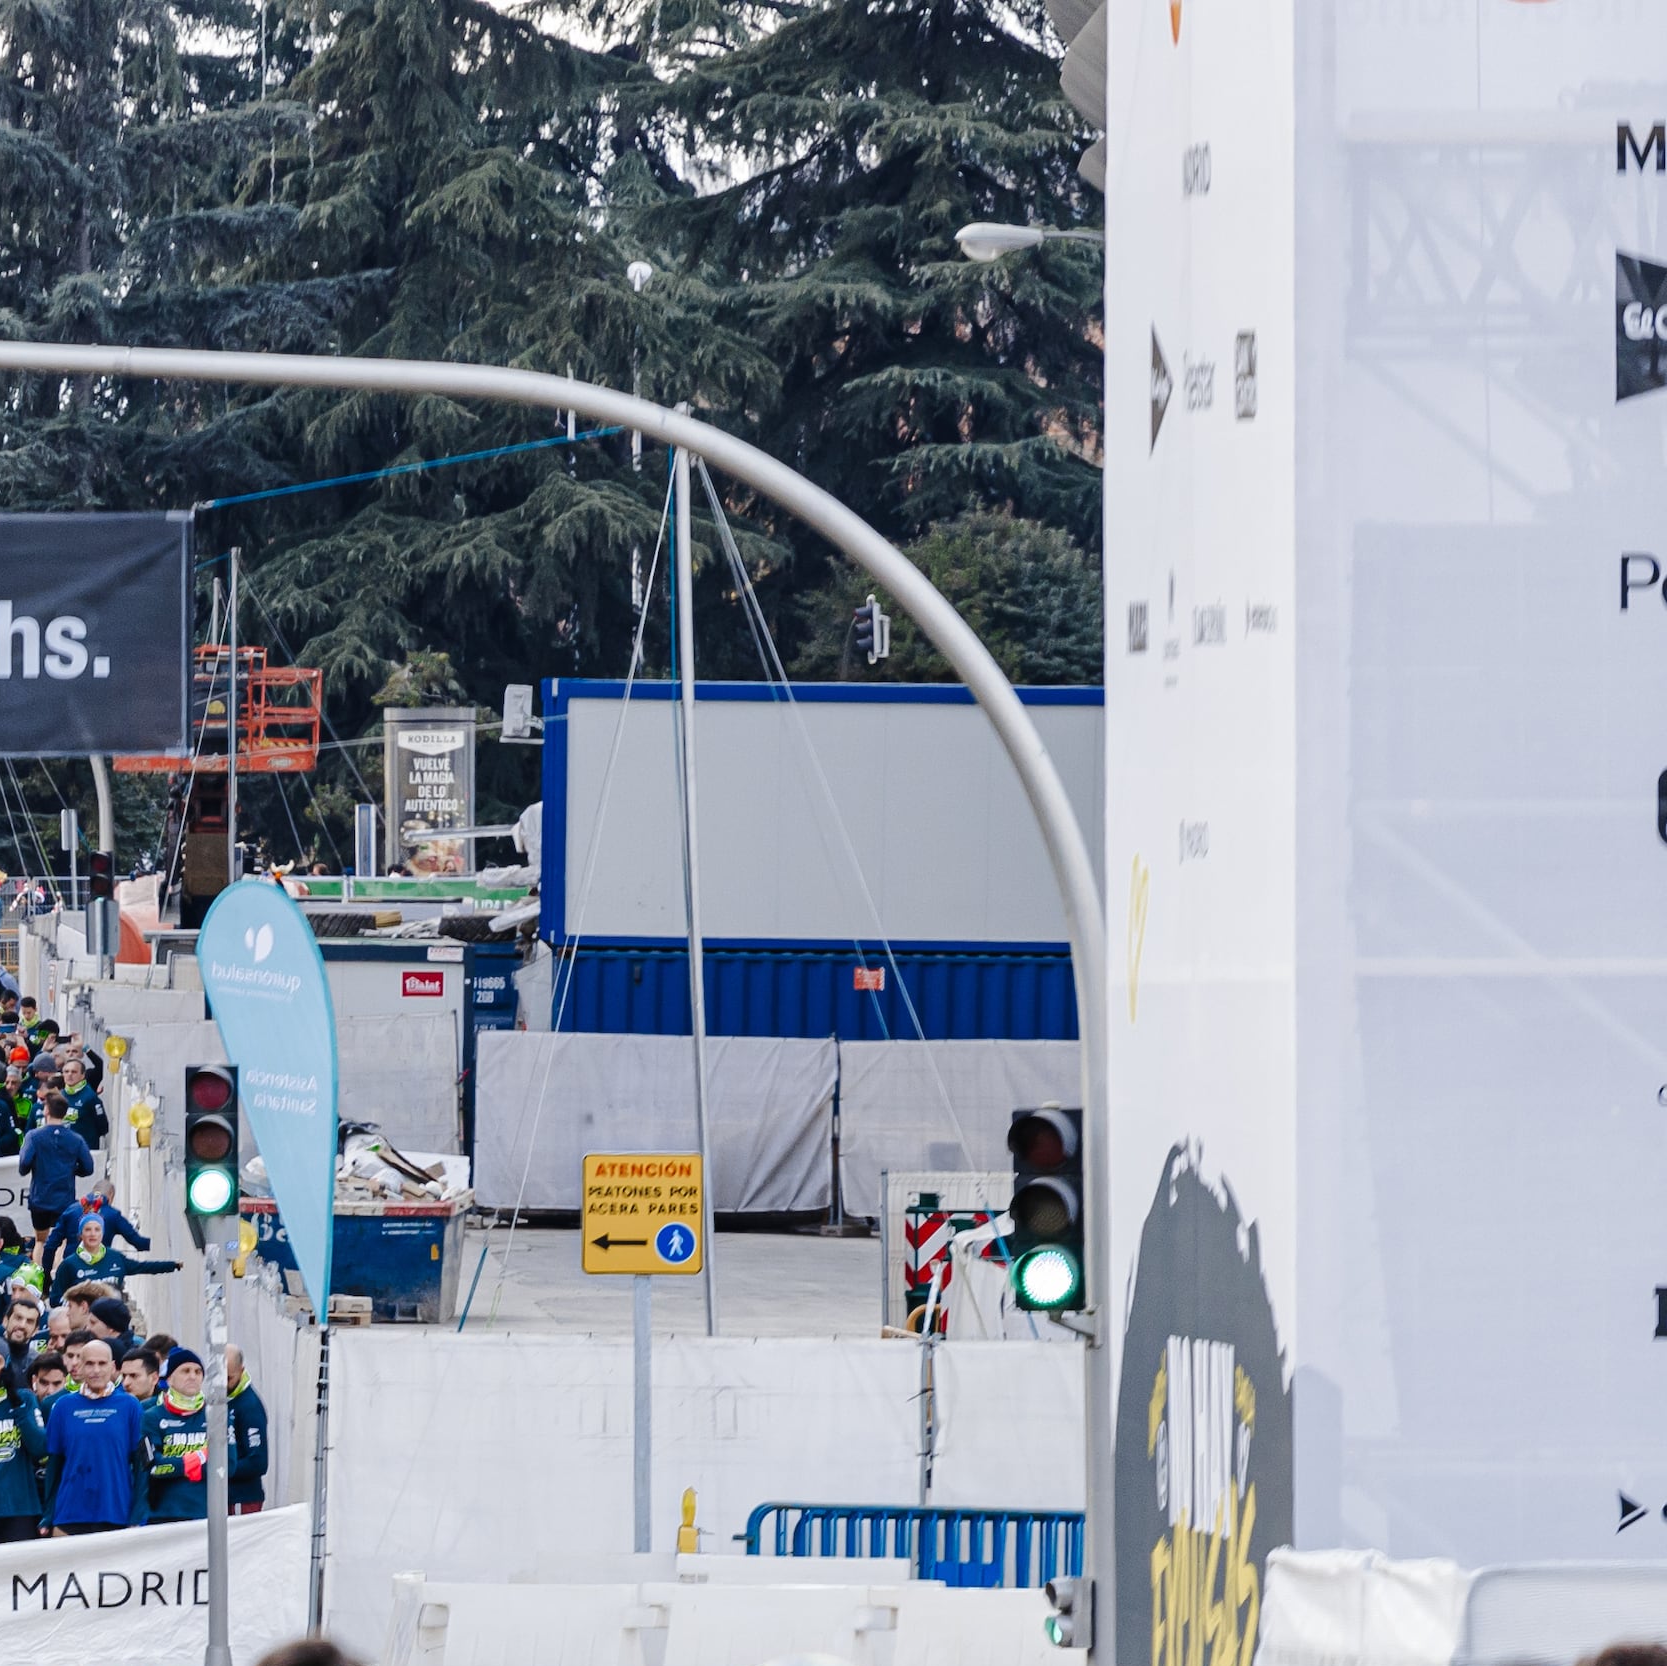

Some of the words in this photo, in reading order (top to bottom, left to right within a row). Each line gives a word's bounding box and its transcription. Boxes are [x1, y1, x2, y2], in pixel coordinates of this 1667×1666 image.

[408, 735, 456, 744] RODILLA
[413, 758, 450, 771] VUELVE
[409, 772, 422, 784] LA
[423, 771, 455, 784] MAGIA
[418, 785, 432, 798] DE
[433, 785, 446, 798] LO
[595, 1160, 692, 1178] ATENCIÓN
[587, 1185, 662, 1199] PEATONES
[669, 1185, 698, 1198] POR
[587, 1202, 639, 1215] ACERA
[647, 1202, 699, 1215] PARES
